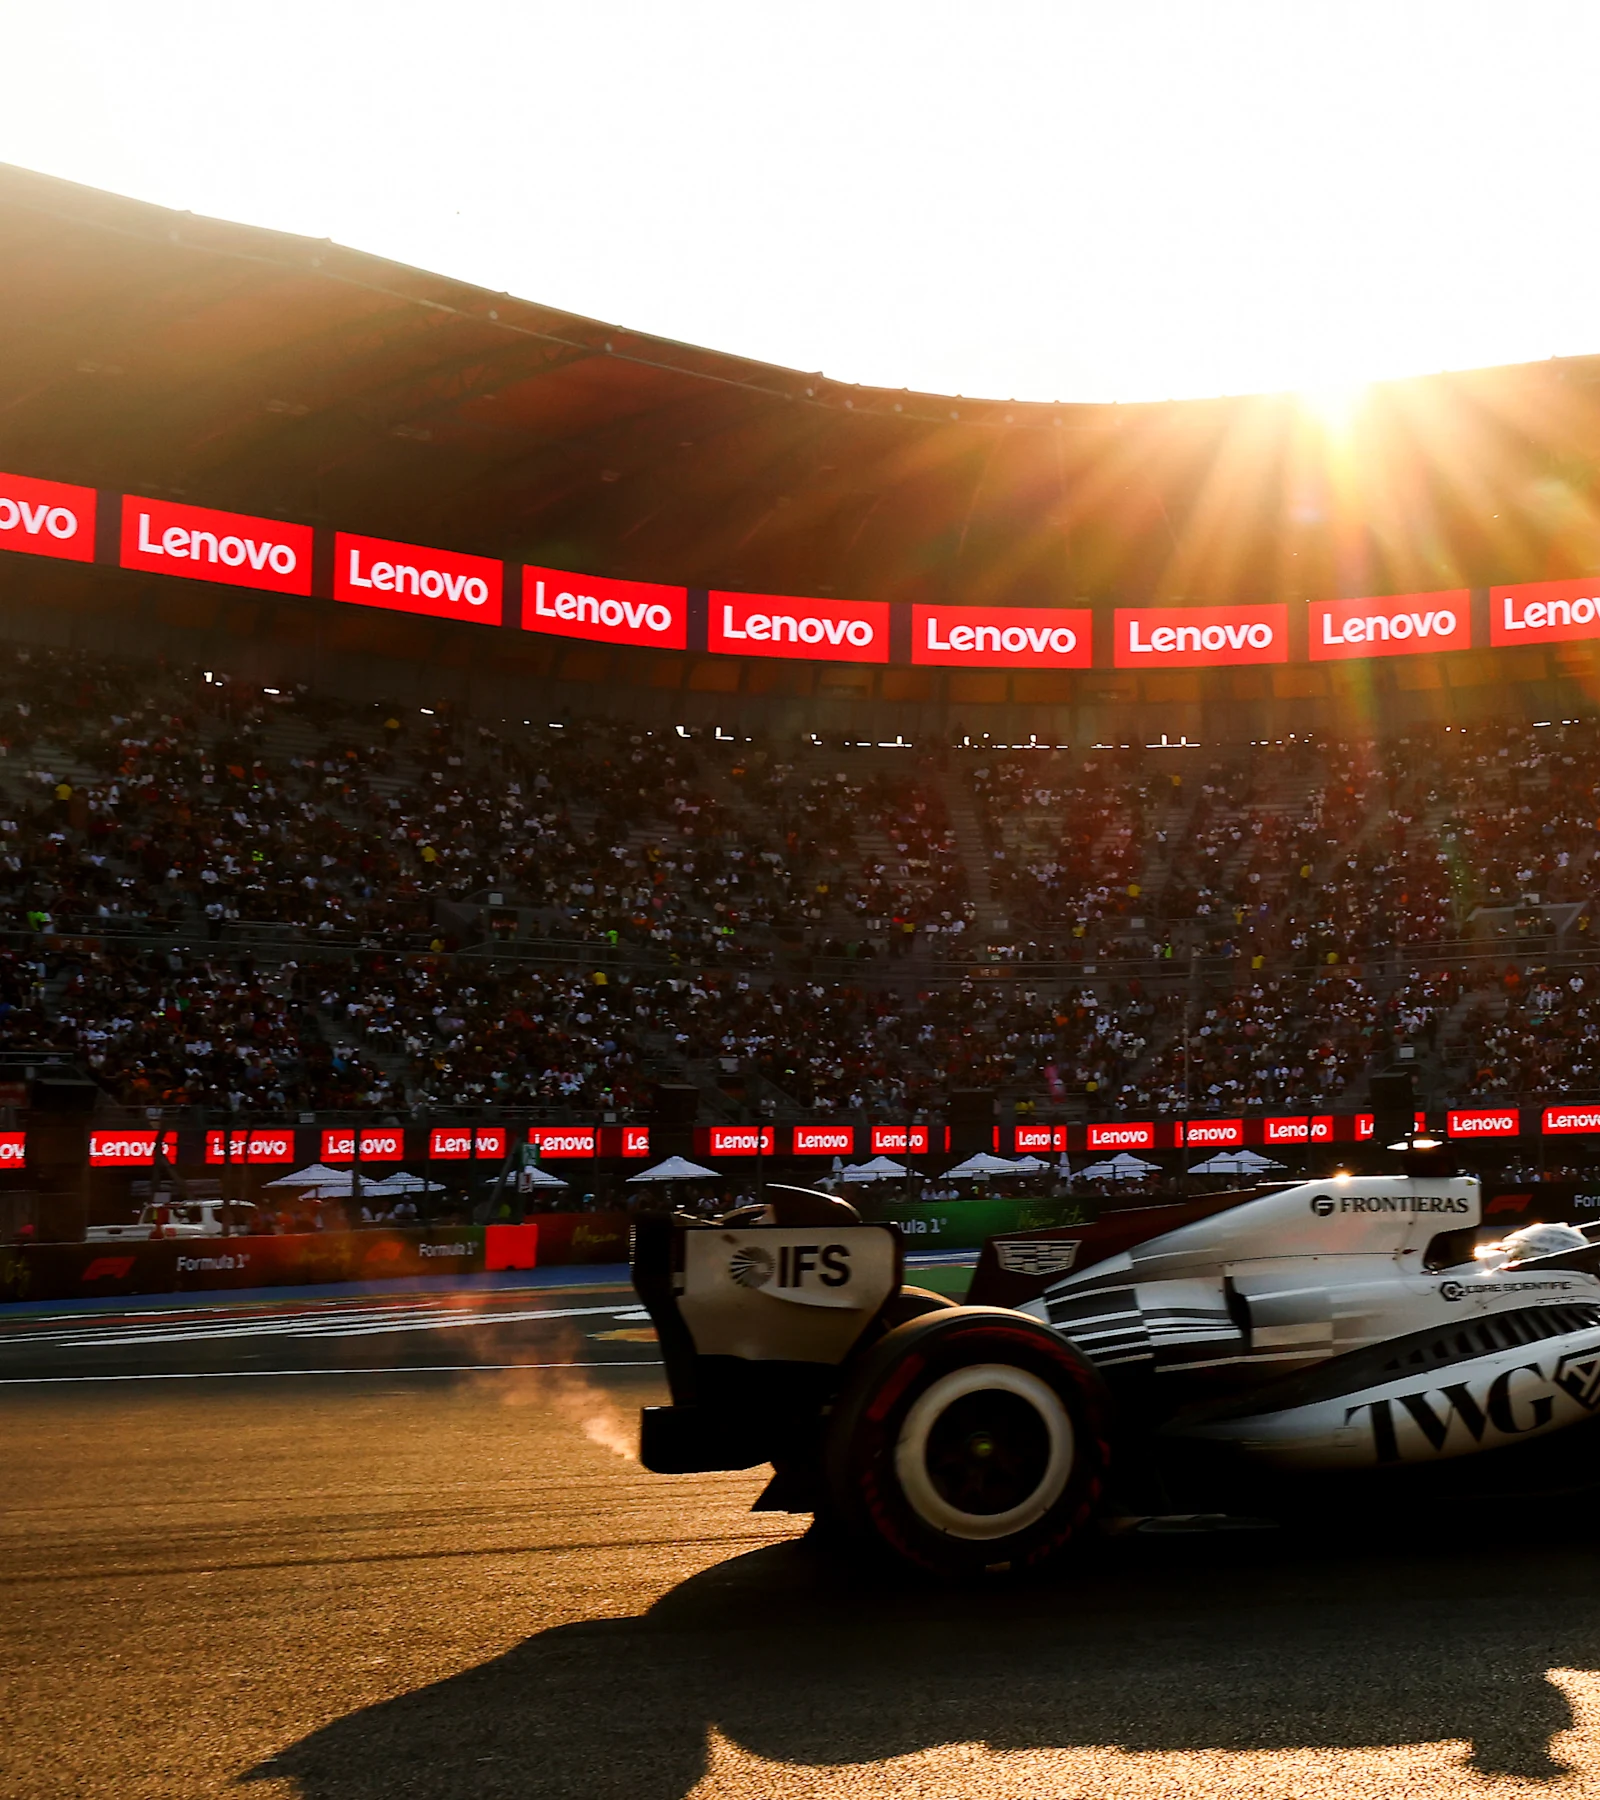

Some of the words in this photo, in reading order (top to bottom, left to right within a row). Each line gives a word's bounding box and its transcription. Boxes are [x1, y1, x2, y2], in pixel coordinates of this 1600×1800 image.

[138, 513, 297, 575] Lenovo
[349, 549, 489, 606] Lenovo
[535, 581, 673, 631] Lenovo
[722, 604, 874, 648] Lenovo
[926, 617, 1077, 654] Lenovo
[1128, 620, 1274, 653] Lenovo
[1322, 609, 1457, 646] Lenovo
[797, 1131, 850, 1149] Lenovo
[1091, 1128, 1149, 1145] Lenovo
[1452, 1114, 1514, 1132] Lenovo
[1339, 1196, 1469, 1214] FRONTIERAS
[176, 1254, 235, 1272] Formula
[418, 1242, 467, 1263] Formula
[776, 1243, 851, 1290] IFS
[1343, 1360, 1557, 1466] TWG
